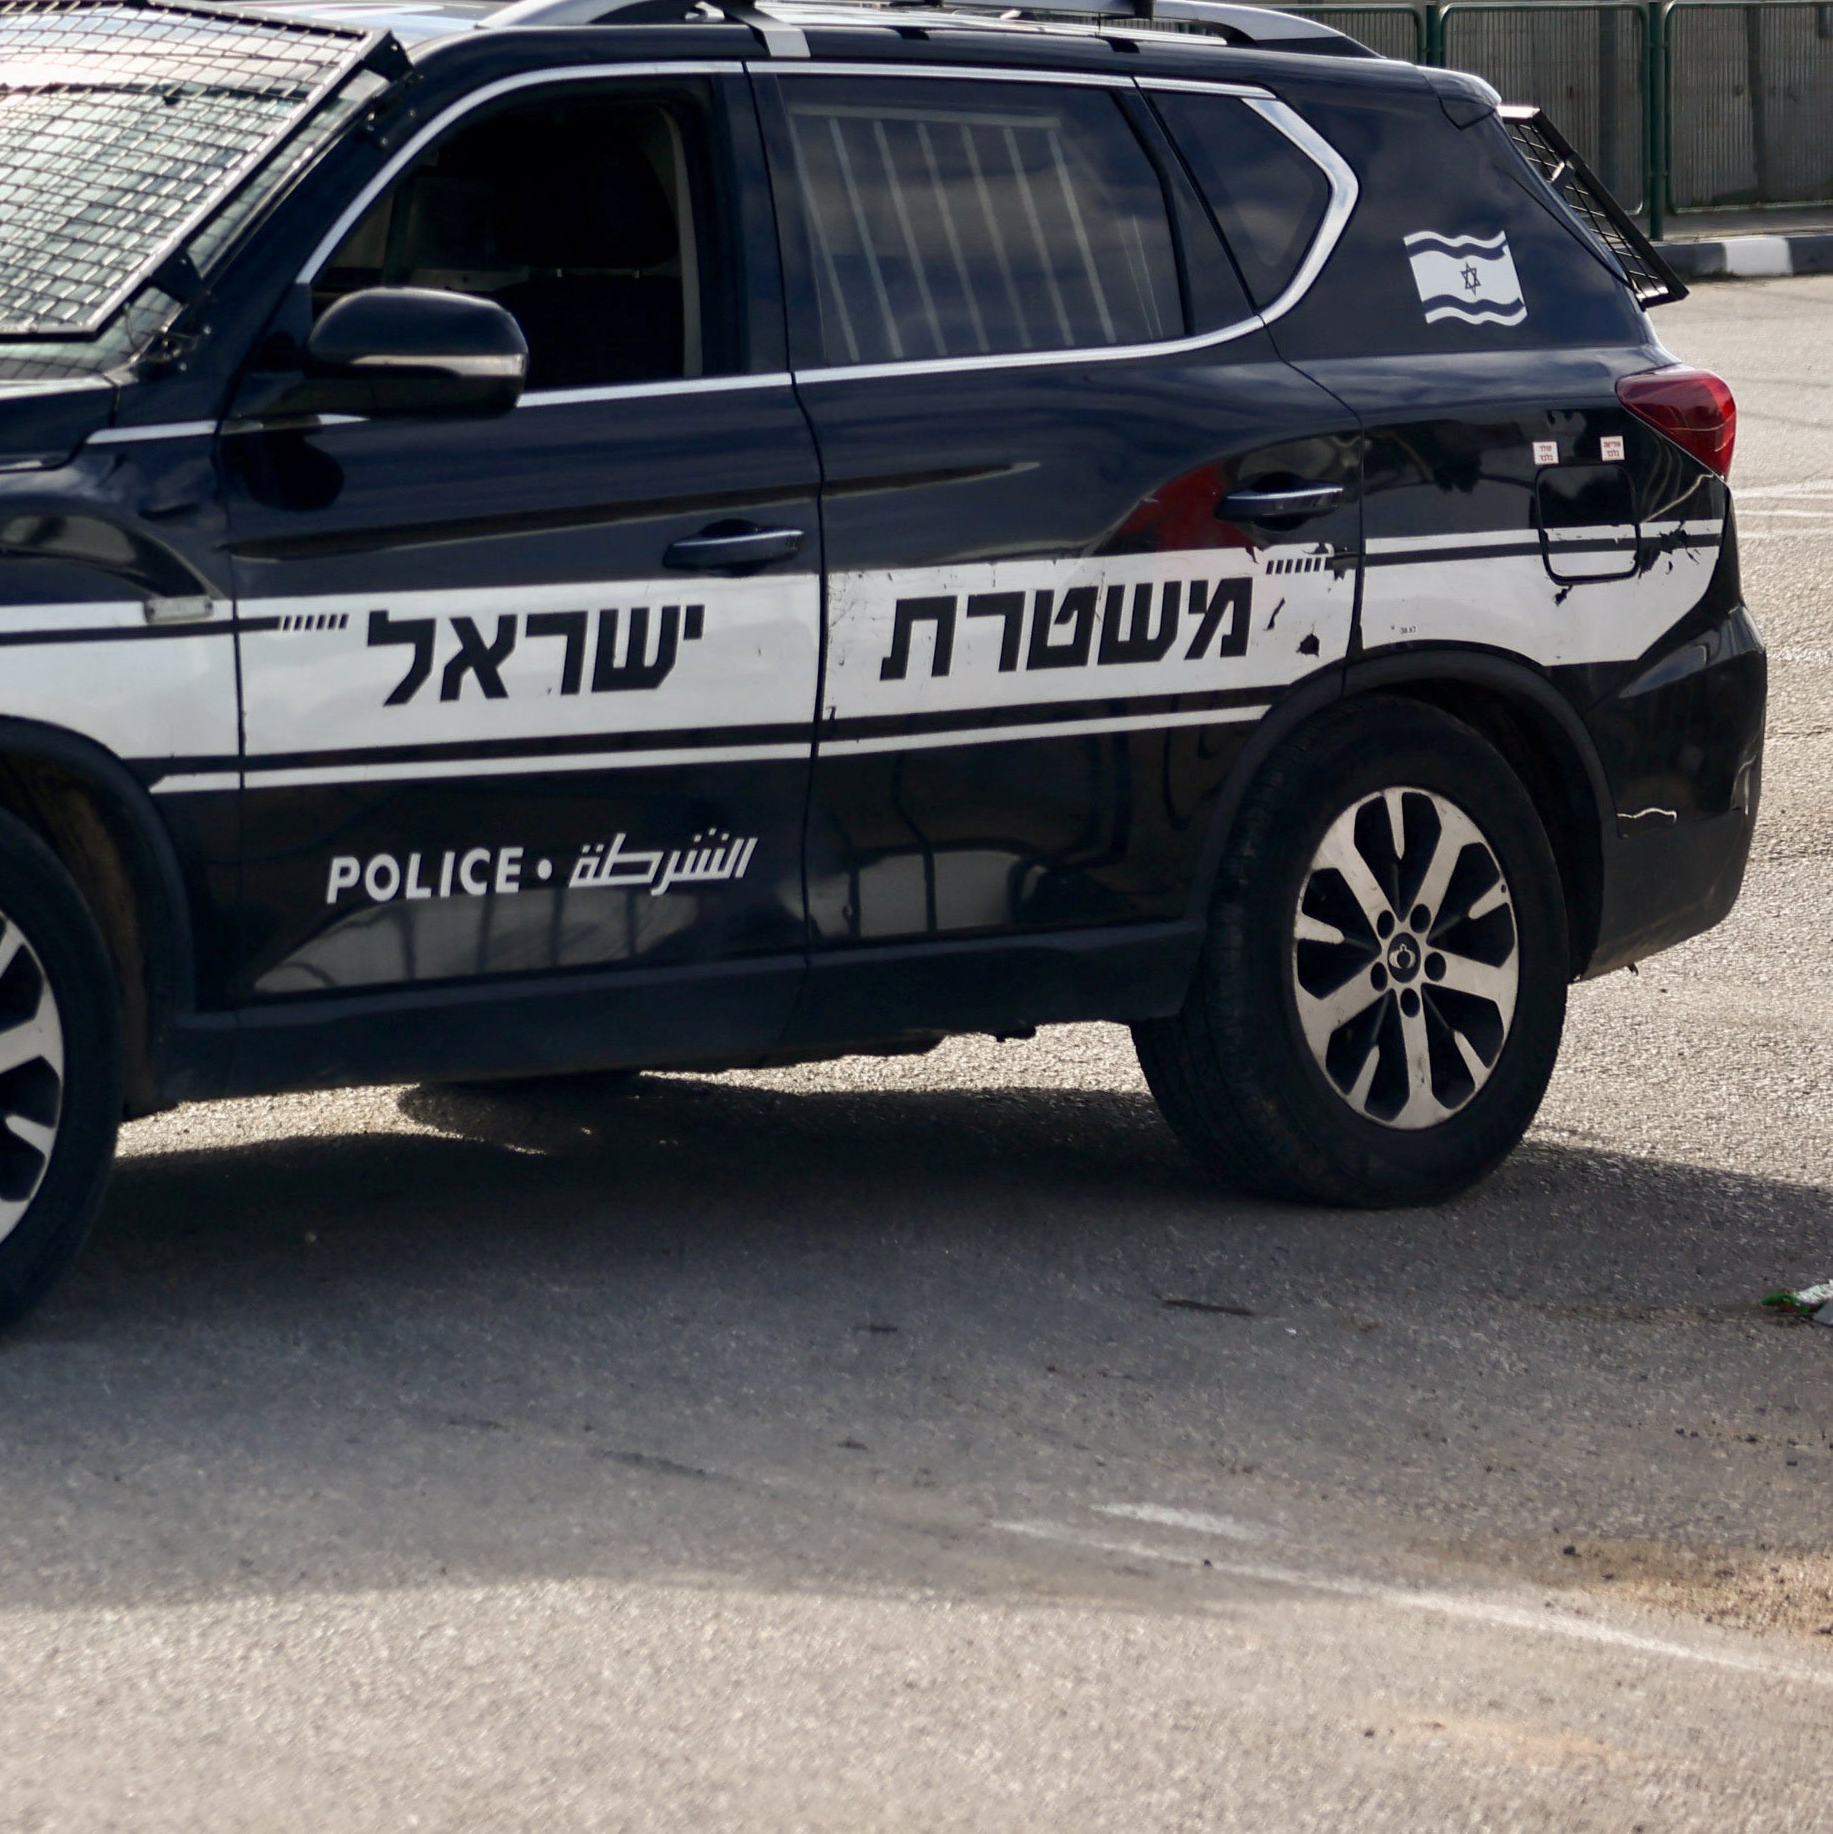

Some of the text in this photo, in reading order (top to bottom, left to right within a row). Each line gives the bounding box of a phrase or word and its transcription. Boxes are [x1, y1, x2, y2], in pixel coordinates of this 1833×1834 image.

[366, 578, 1253, 707] משטרת ישראל
[326, 847, 524, 904] POLICE
[568, 828, 758, 896] الشرطة
